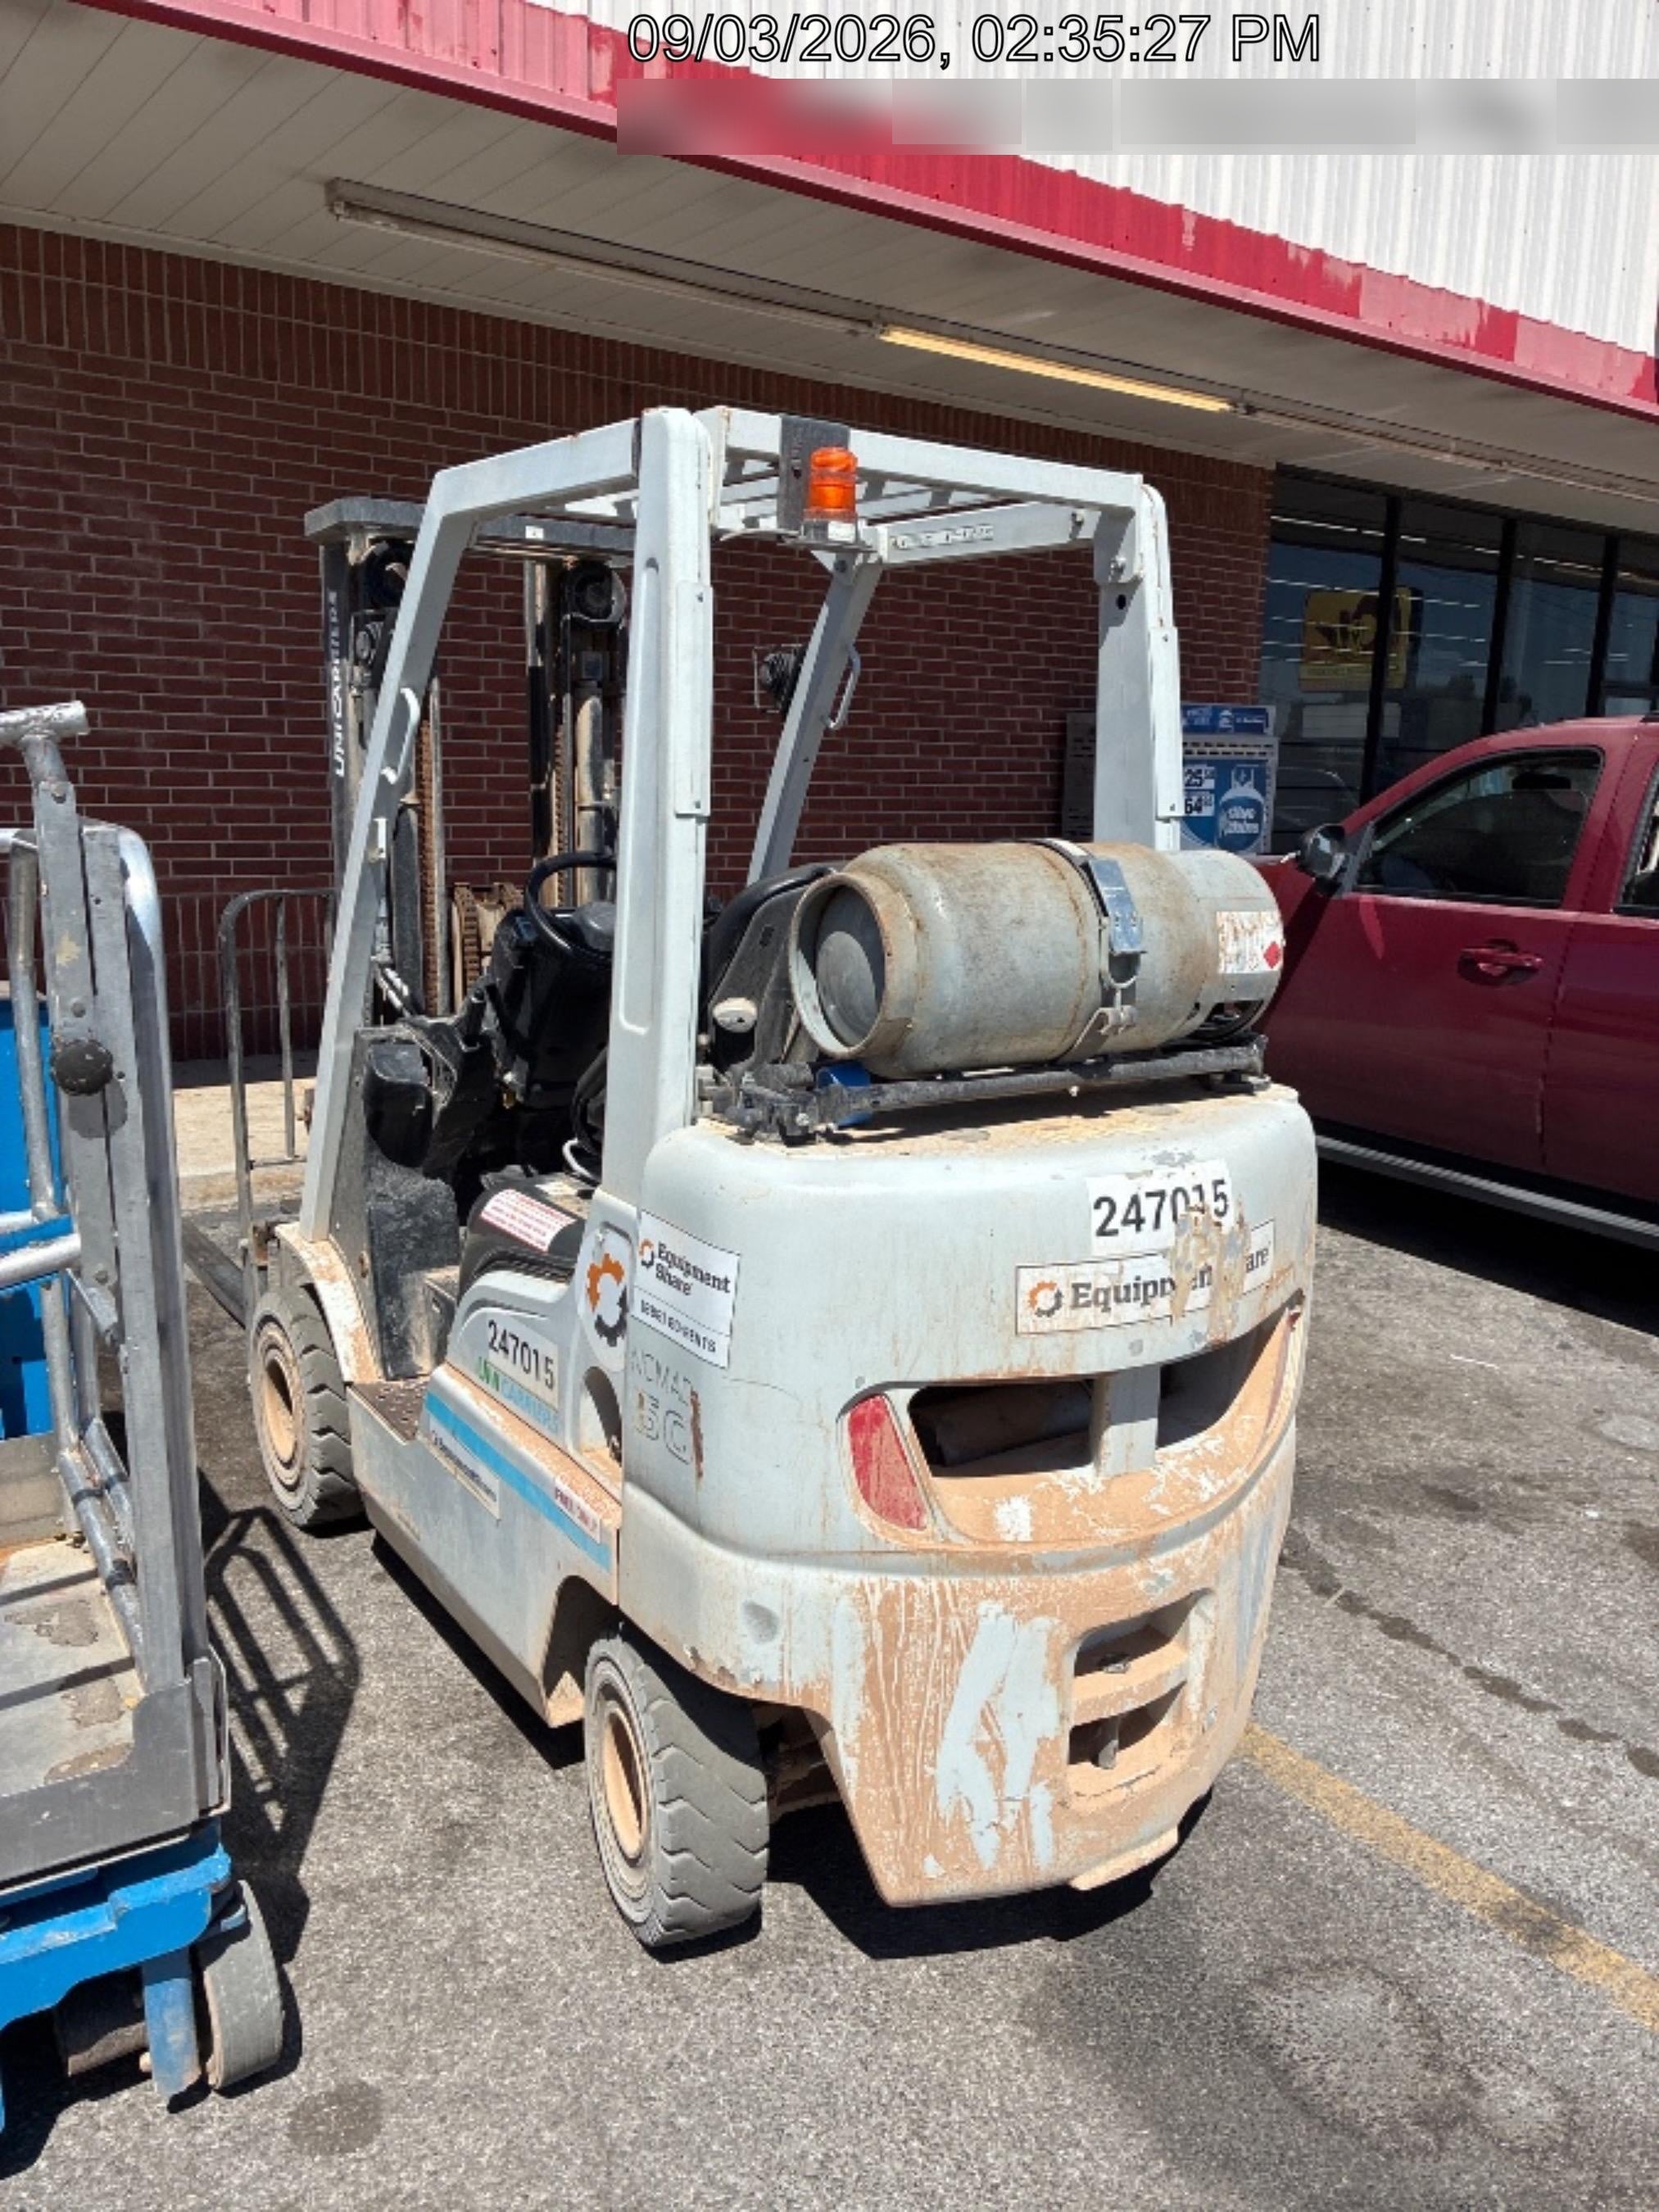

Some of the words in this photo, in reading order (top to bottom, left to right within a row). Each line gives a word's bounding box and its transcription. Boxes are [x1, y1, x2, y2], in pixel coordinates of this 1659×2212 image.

[655, 1262, 691, 1296] Share
[658, 1240, 731, 1294] Equipment
[487, 1319, 555, 1390] 247015
